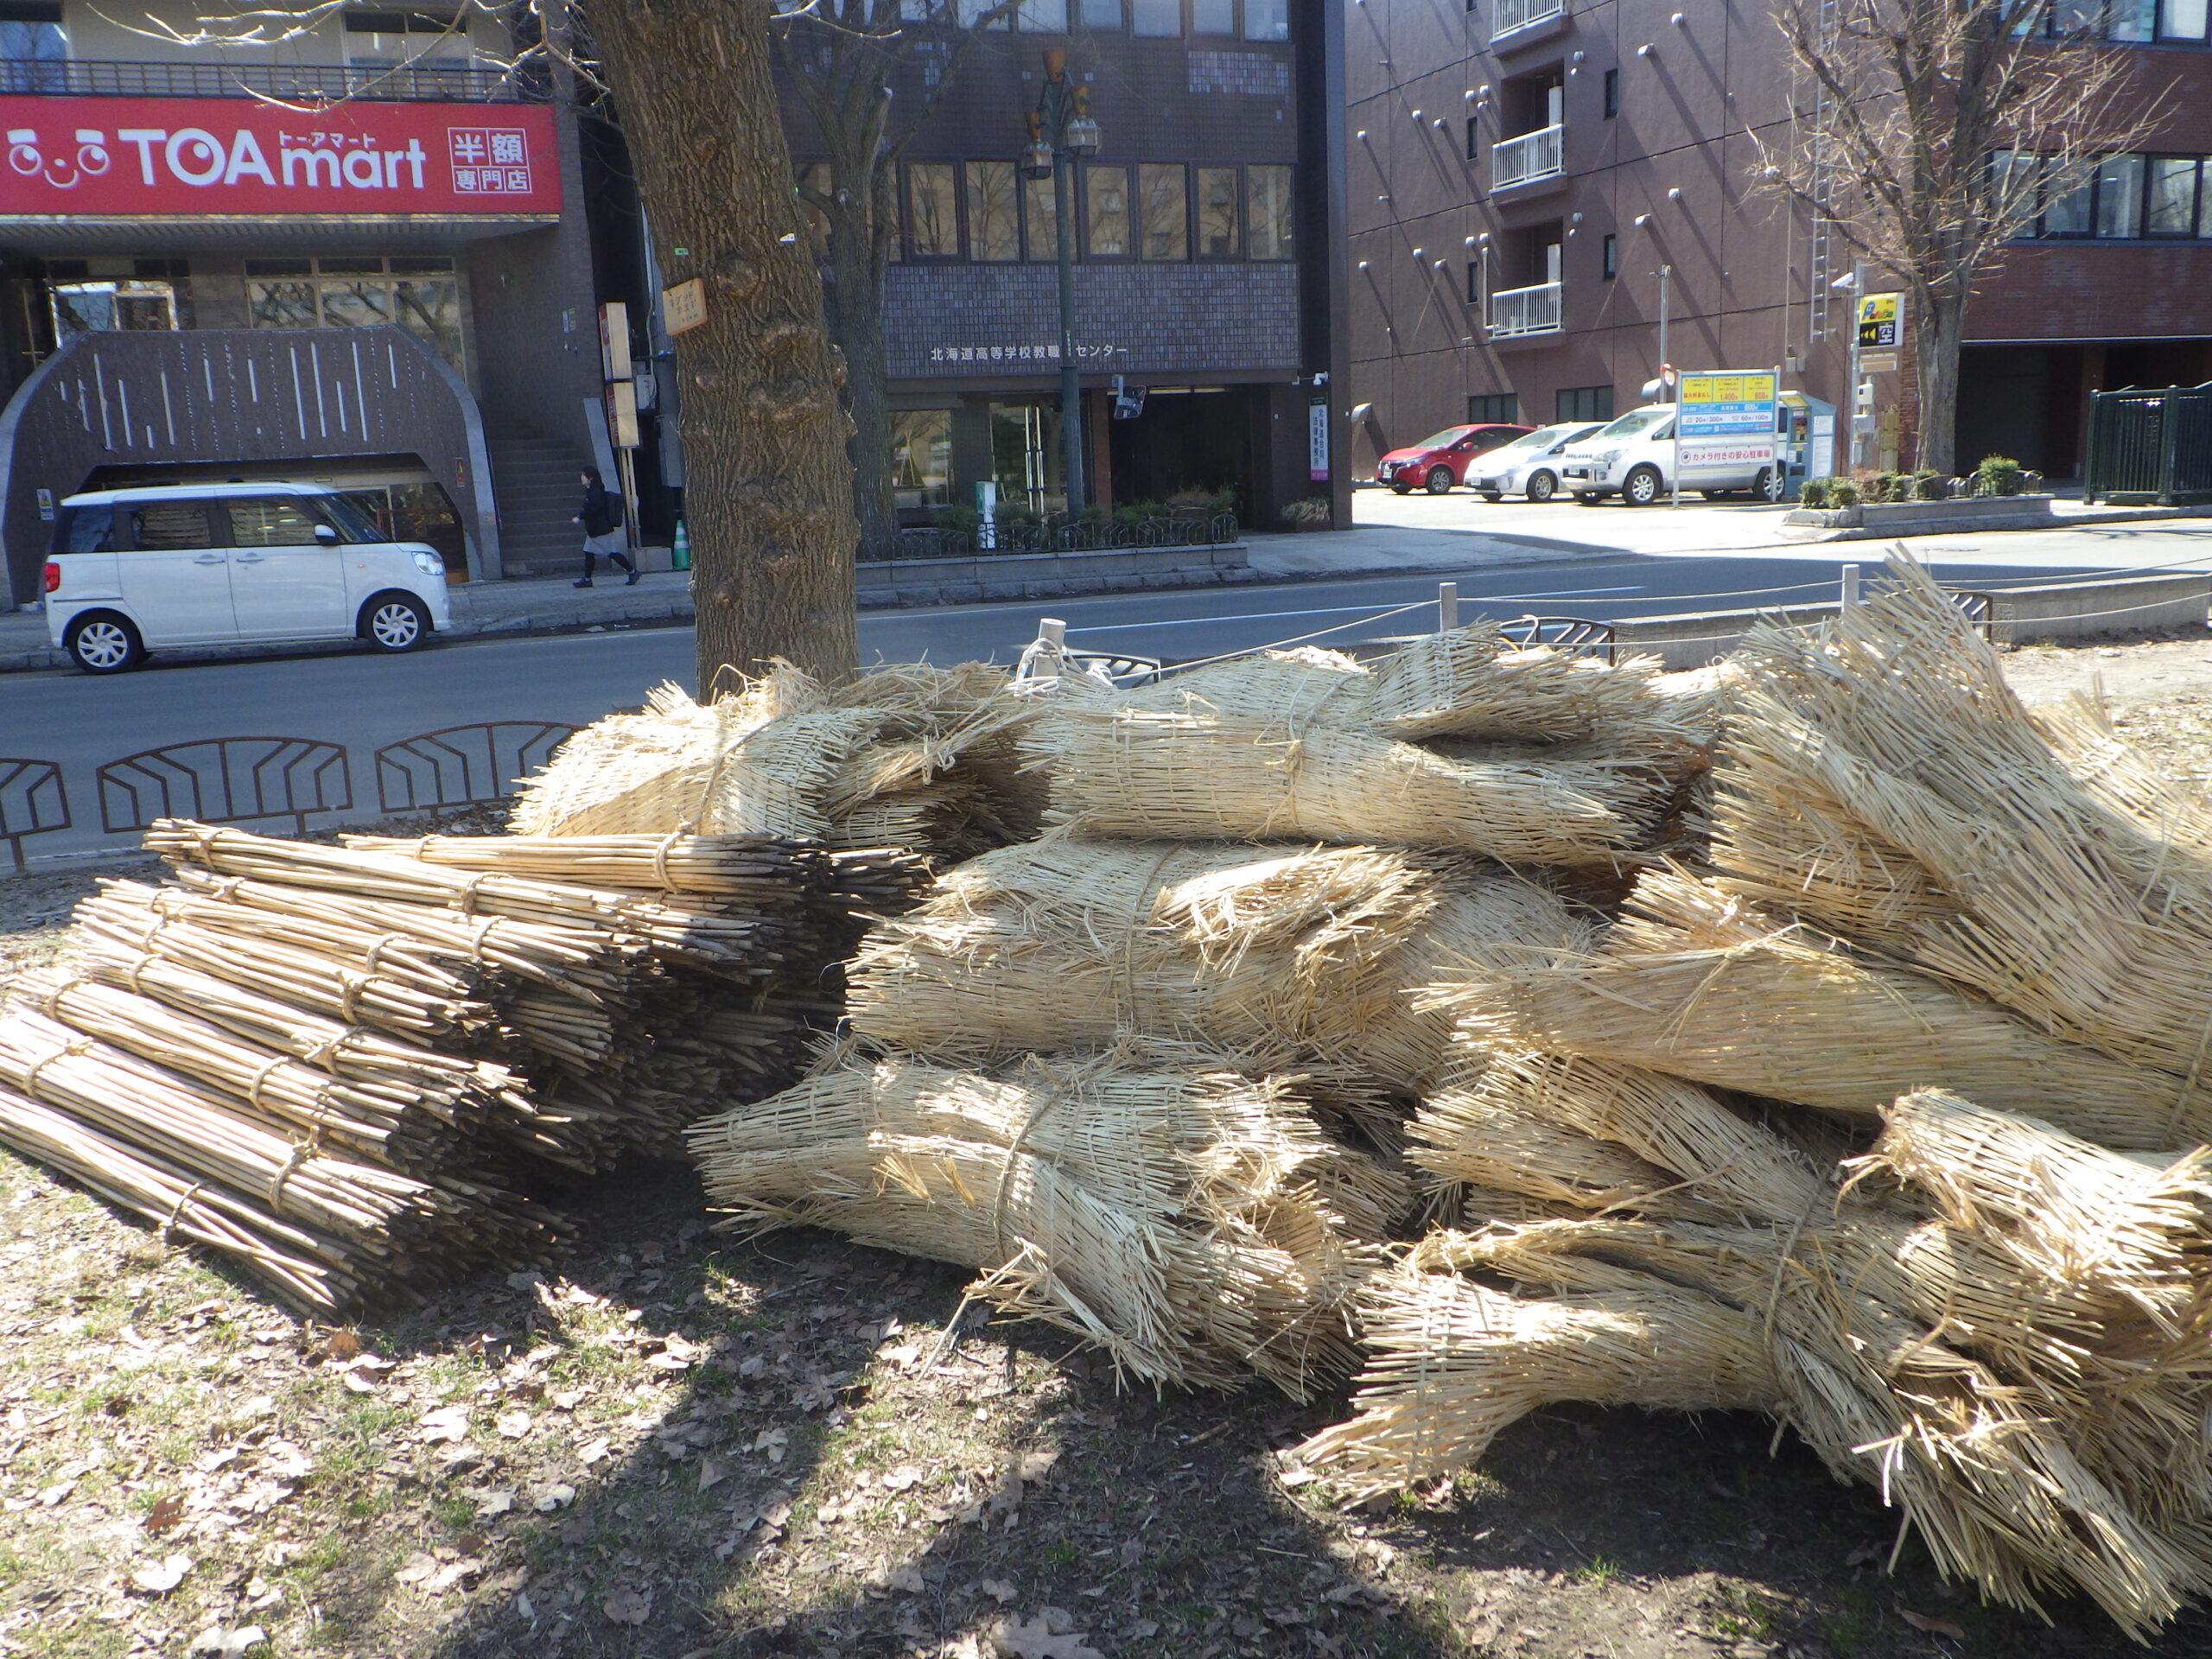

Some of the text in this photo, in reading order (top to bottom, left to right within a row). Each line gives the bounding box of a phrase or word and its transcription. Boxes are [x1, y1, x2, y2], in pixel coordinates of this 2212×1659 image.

[278, 130, 377, 149] トーアマート
[454, 132, 524, 164] 半額
[117, 127, 427, 189] TOA mart
[454, 169, 529, 190] 専門店
[930, 344, 1128, 361] 北海道高等学校教職センター
[1692, 449, 1771, 461] カメラ付きの安心駐車場
